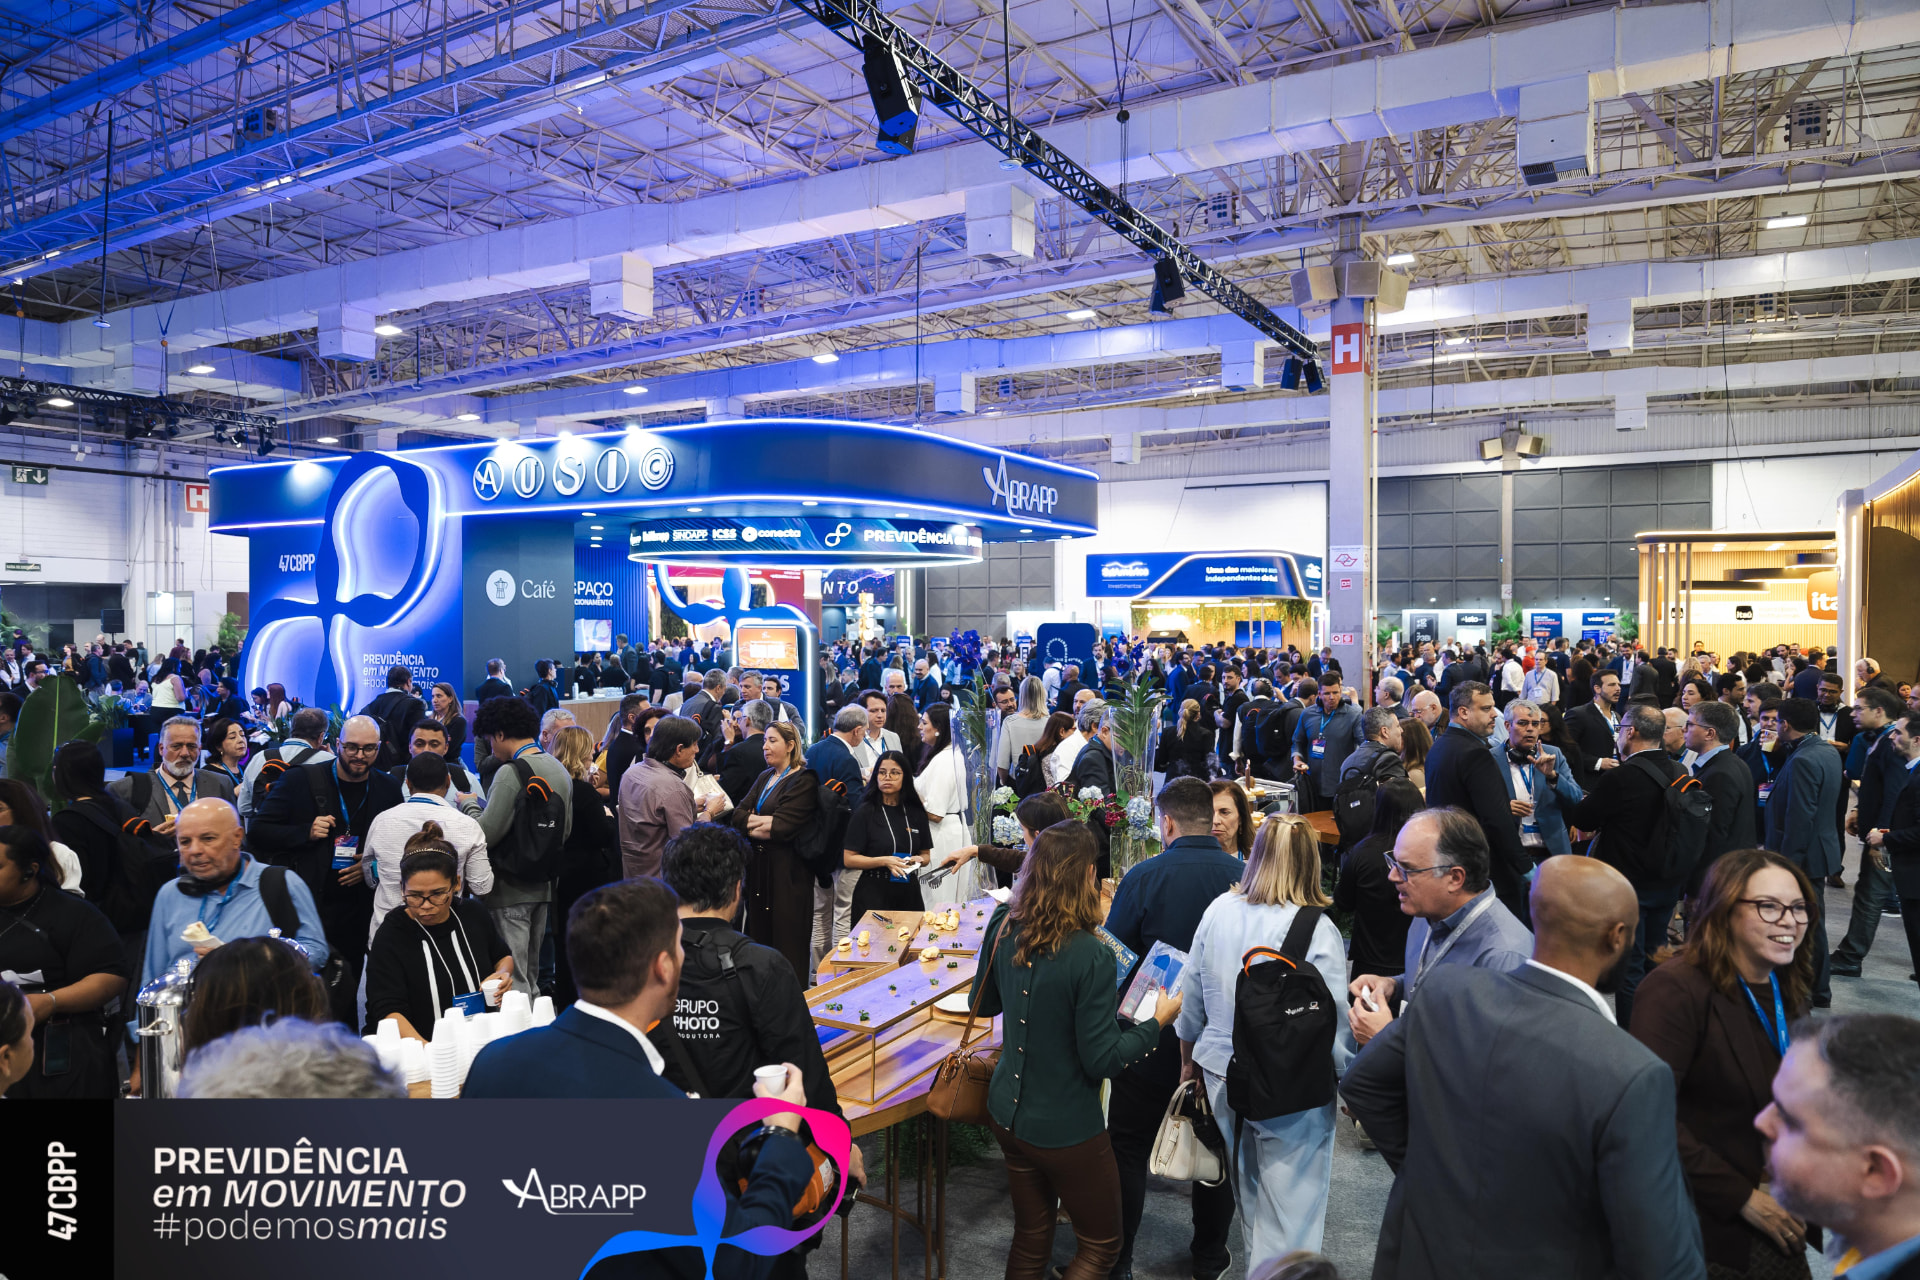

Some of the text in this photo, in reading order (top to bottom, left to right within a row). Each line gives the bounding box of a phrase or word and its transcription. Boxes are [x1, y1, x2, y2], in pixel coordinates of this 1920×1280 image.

[1335, 333, 1360, 364] H
[189, 487, 210, 509] H
[863, 527, 954, 546] PREVIDÊNCIA
[278, 553, 316, 572] 47CBPP
[521, 579, 556, 599] Café
[363, 650, 425, 666] PREVIDÊNCIA
[362, 666, 378, 676] em
[673, 1015, 720, 1030] PHOTO
